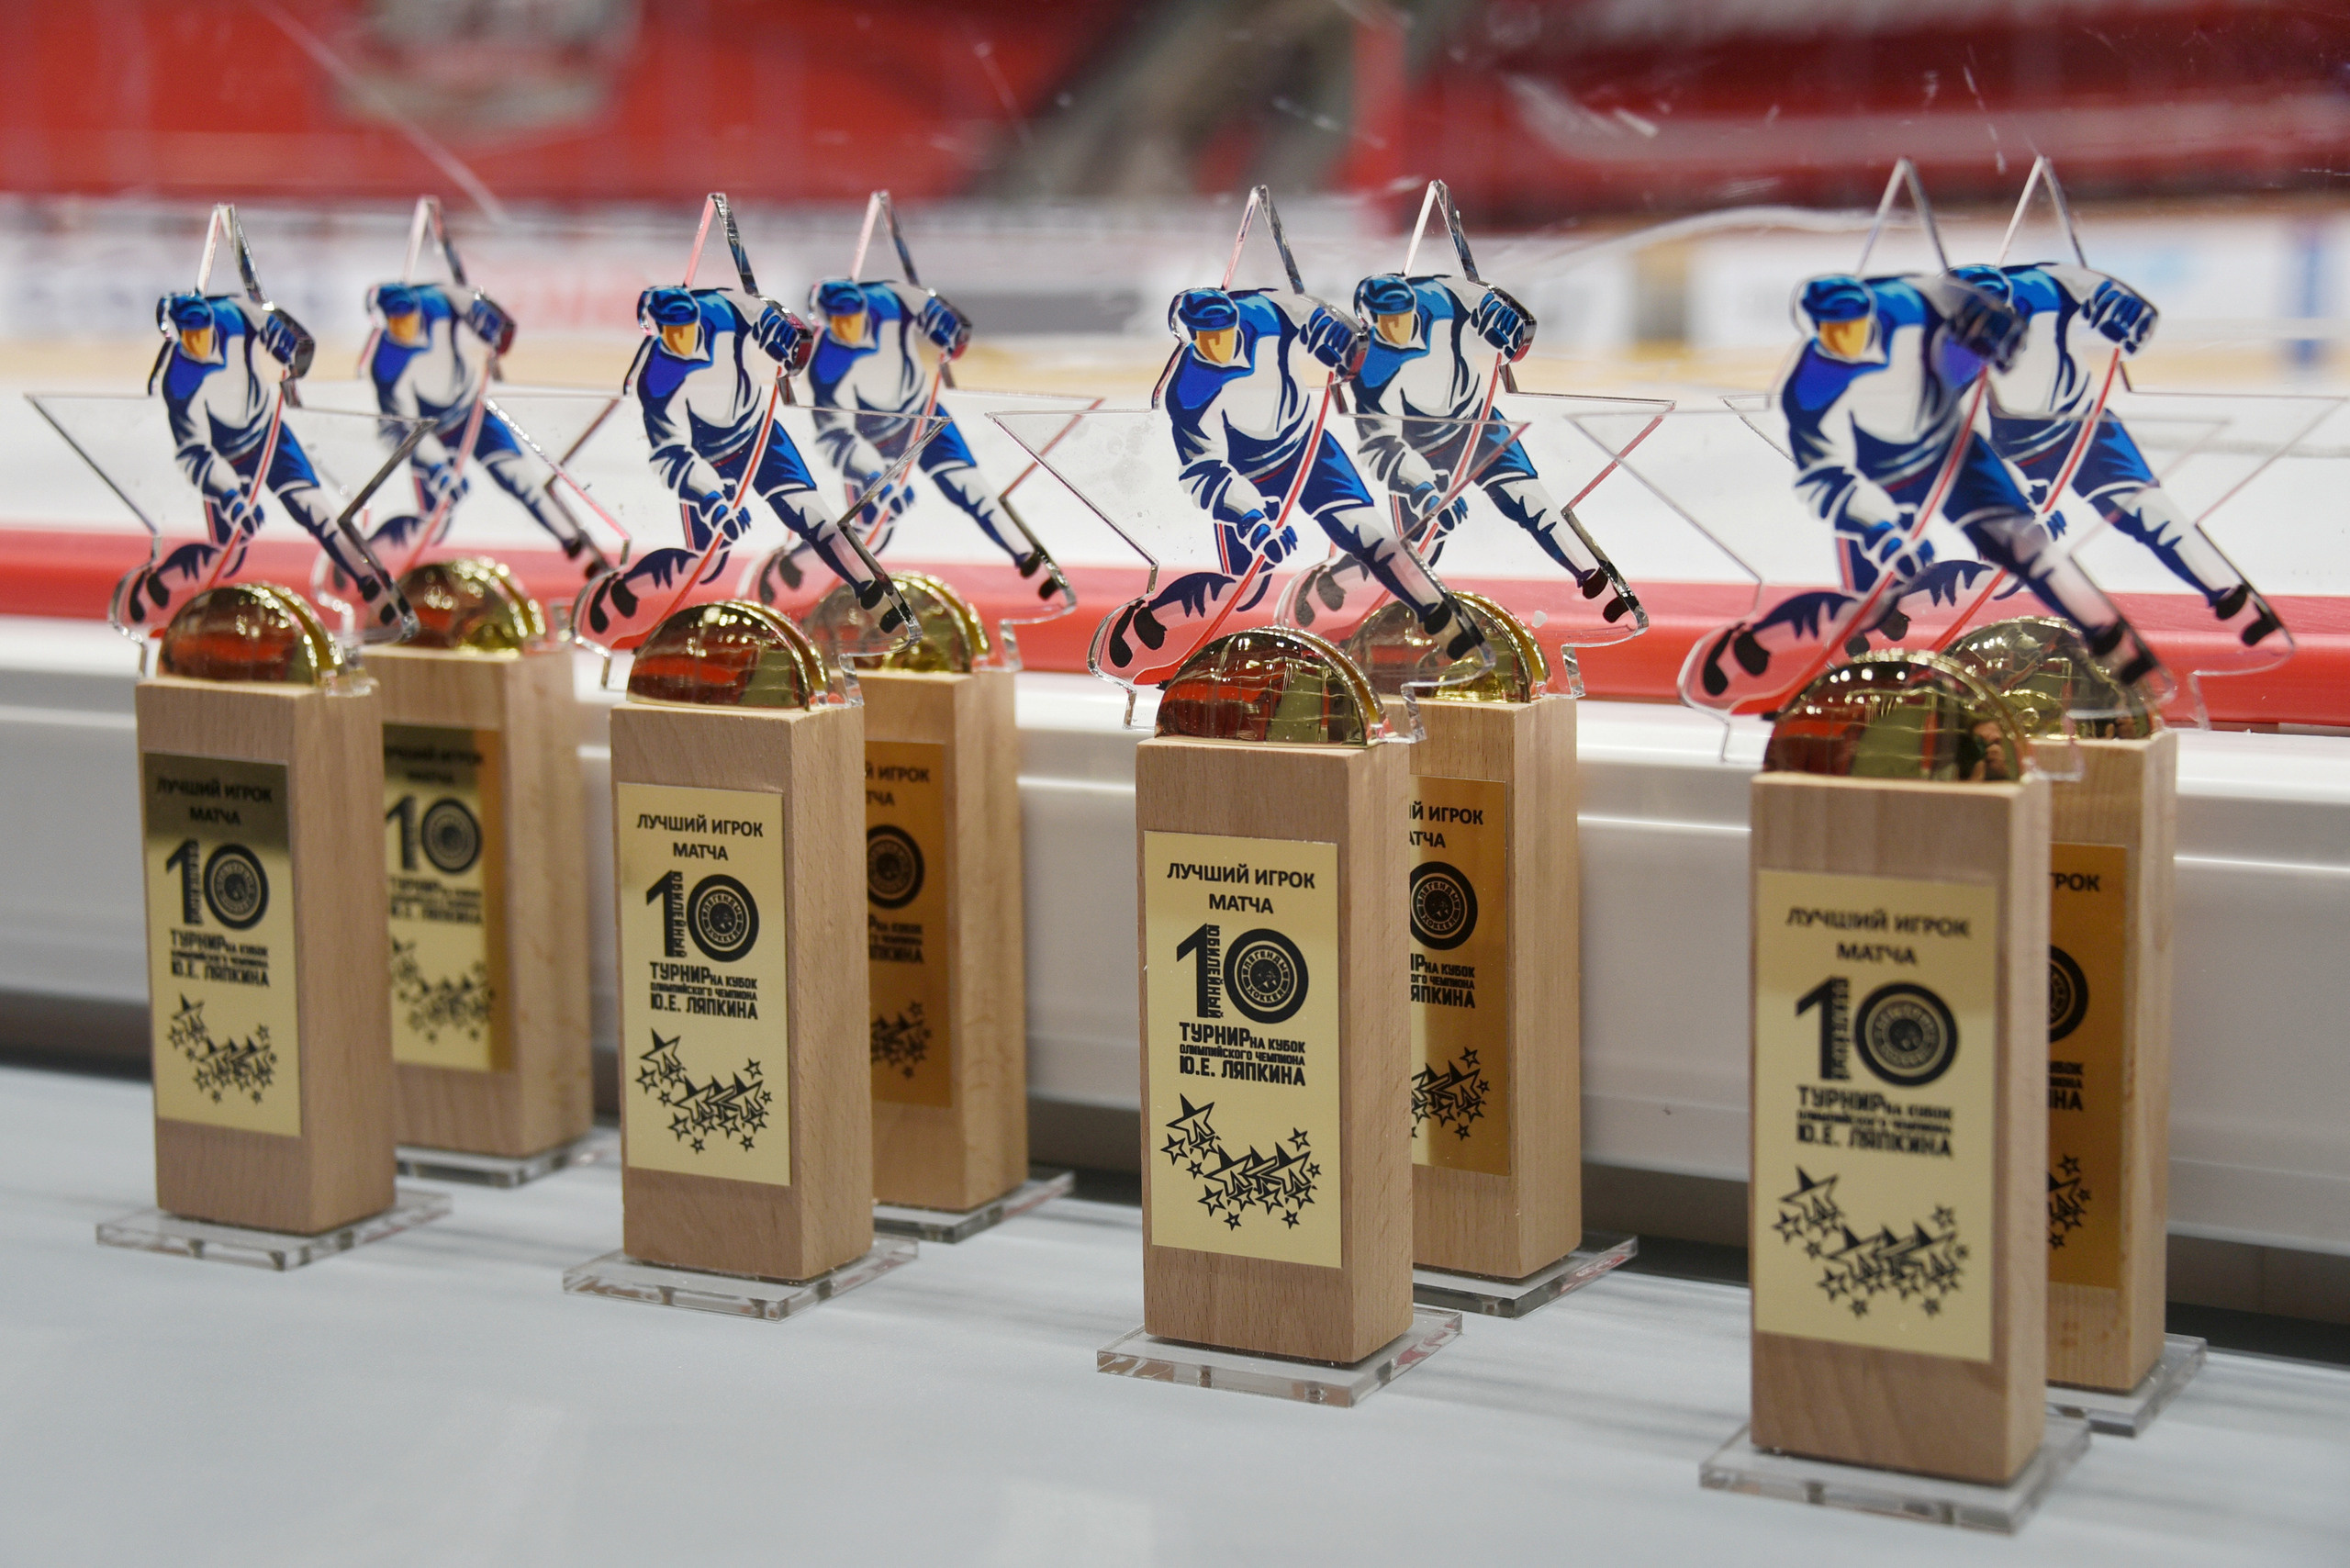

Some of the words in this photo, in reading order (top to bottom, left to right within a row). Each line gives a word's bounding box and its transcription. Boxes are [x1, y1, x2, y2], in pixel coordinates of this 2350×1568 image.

[866, 790, 895, 806] ТЧА
[637, 814, 707, 834] ЛУЧШИЙ
[711, 819, 764, 837] ИГРОК
[1429, 806, 1483, 825] ИГРОК
[673, 842, 729, 861] МАТЧА
[166, 838, 270, 933] 10
[1167, 862, 1249, 884] ЛУЧШИЙ
[1255, 869, 1315, 890] ИГРОК
[2050, 872, 2100, 891] РОК
[646, 869, 759, 962] 10
[1209, 893, 1273, 914] МАТЧА
[1894, 915, 1970, 938] ИГРОК
[1244, 949, 1288, 973] ЛЕГЕНДЫ
[1837, 941, 1917, 966] МАТЧА
[649, 961, 711, 985] ТУРНИР
[711, 974, 723, 987] НА
[726, 976, 757, 990] КУБОК
[1177, 923, 1309, 1025] 10
[1207, 924, 1224, 1019] ЮБИЛЕЙНЫЙ
[1425, 961, 1438, 974] НА
[1441, 963, 1475, 979] КУБОК
[650, 992, 682, 1013] Ю.Е.
[687, 996, 759, 1020] ЛЯПКИНА
[1411, 984, 1476, 1009] ЯПКИНА
[1179, 1021, 1251, 1047] ТУРНИР
[1250, 1036, 1266, 1050] НА
[1269, 1037, 1305, 1054] КУБОК
[1796, 975, 1958, 1089] 10
[1180, 1043, 1253, 1060] ОЛИМПИЙСКОГО
[1256, 1051, 1305, 1067] ЧЕМПИОНА
[1180, 1055, 1215, 1078] Ю.Е.
[1222, 1059, 1306, 1087] ЛЯПКИНА
